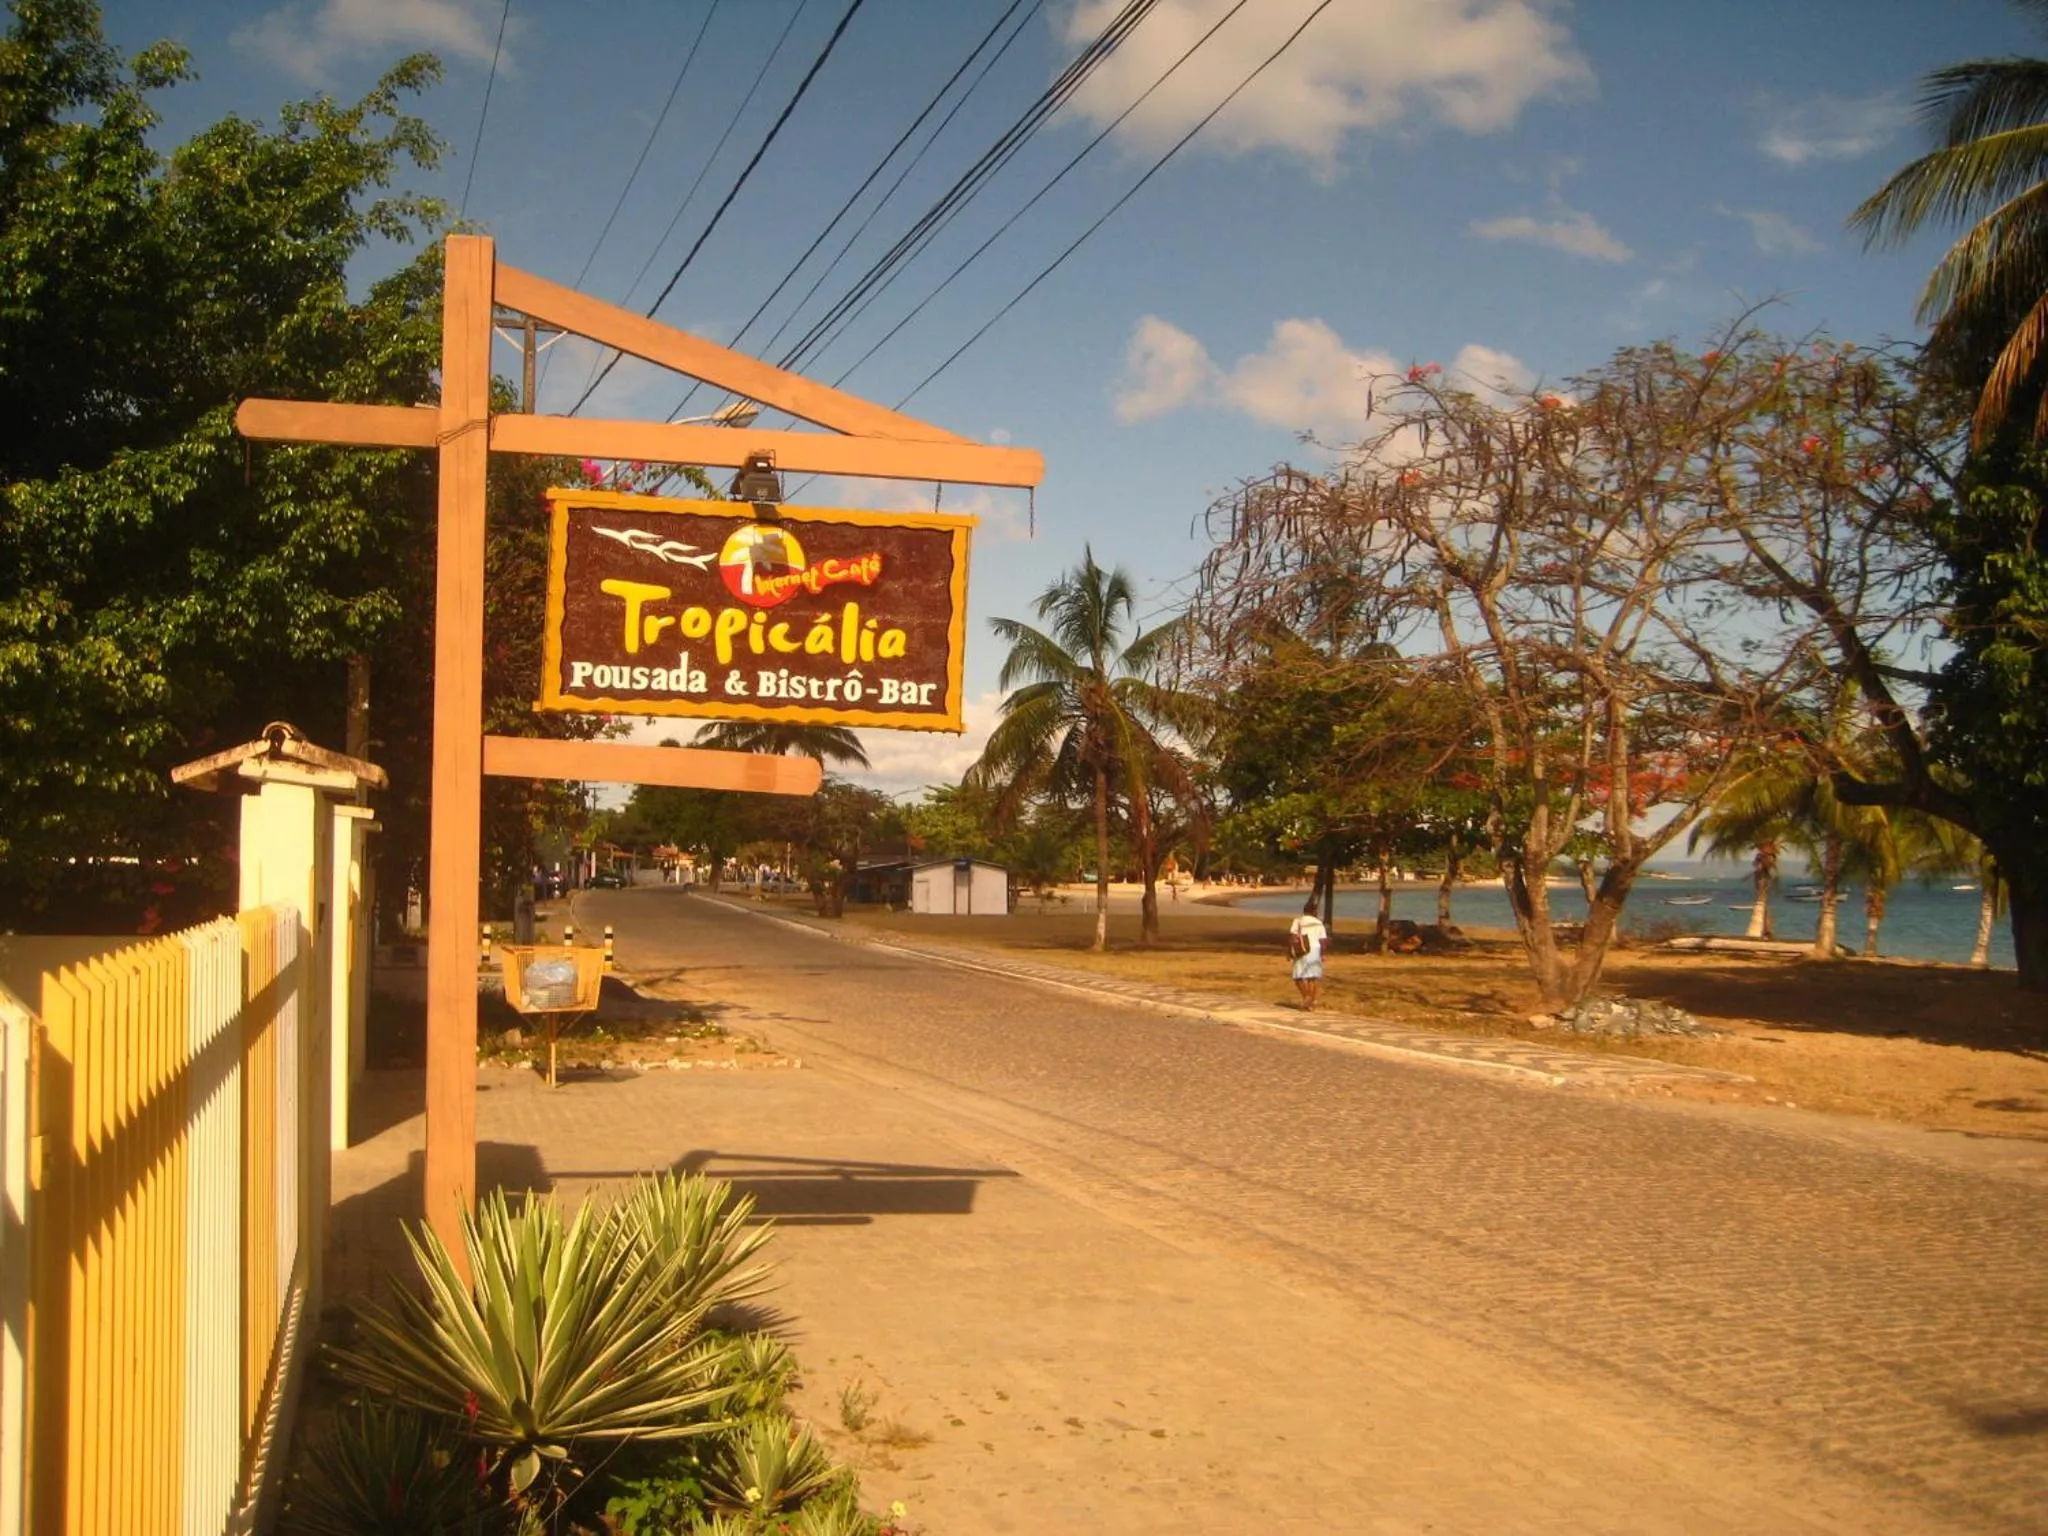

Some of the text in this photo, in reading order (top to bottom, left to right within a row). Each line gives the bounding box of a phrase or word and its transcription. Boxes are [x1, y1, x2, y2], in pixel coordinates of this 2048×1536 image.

[601, 579, 906, 665] Tropicália
[569, 651, 937, 706] Pousada & Bistrô-Bar
